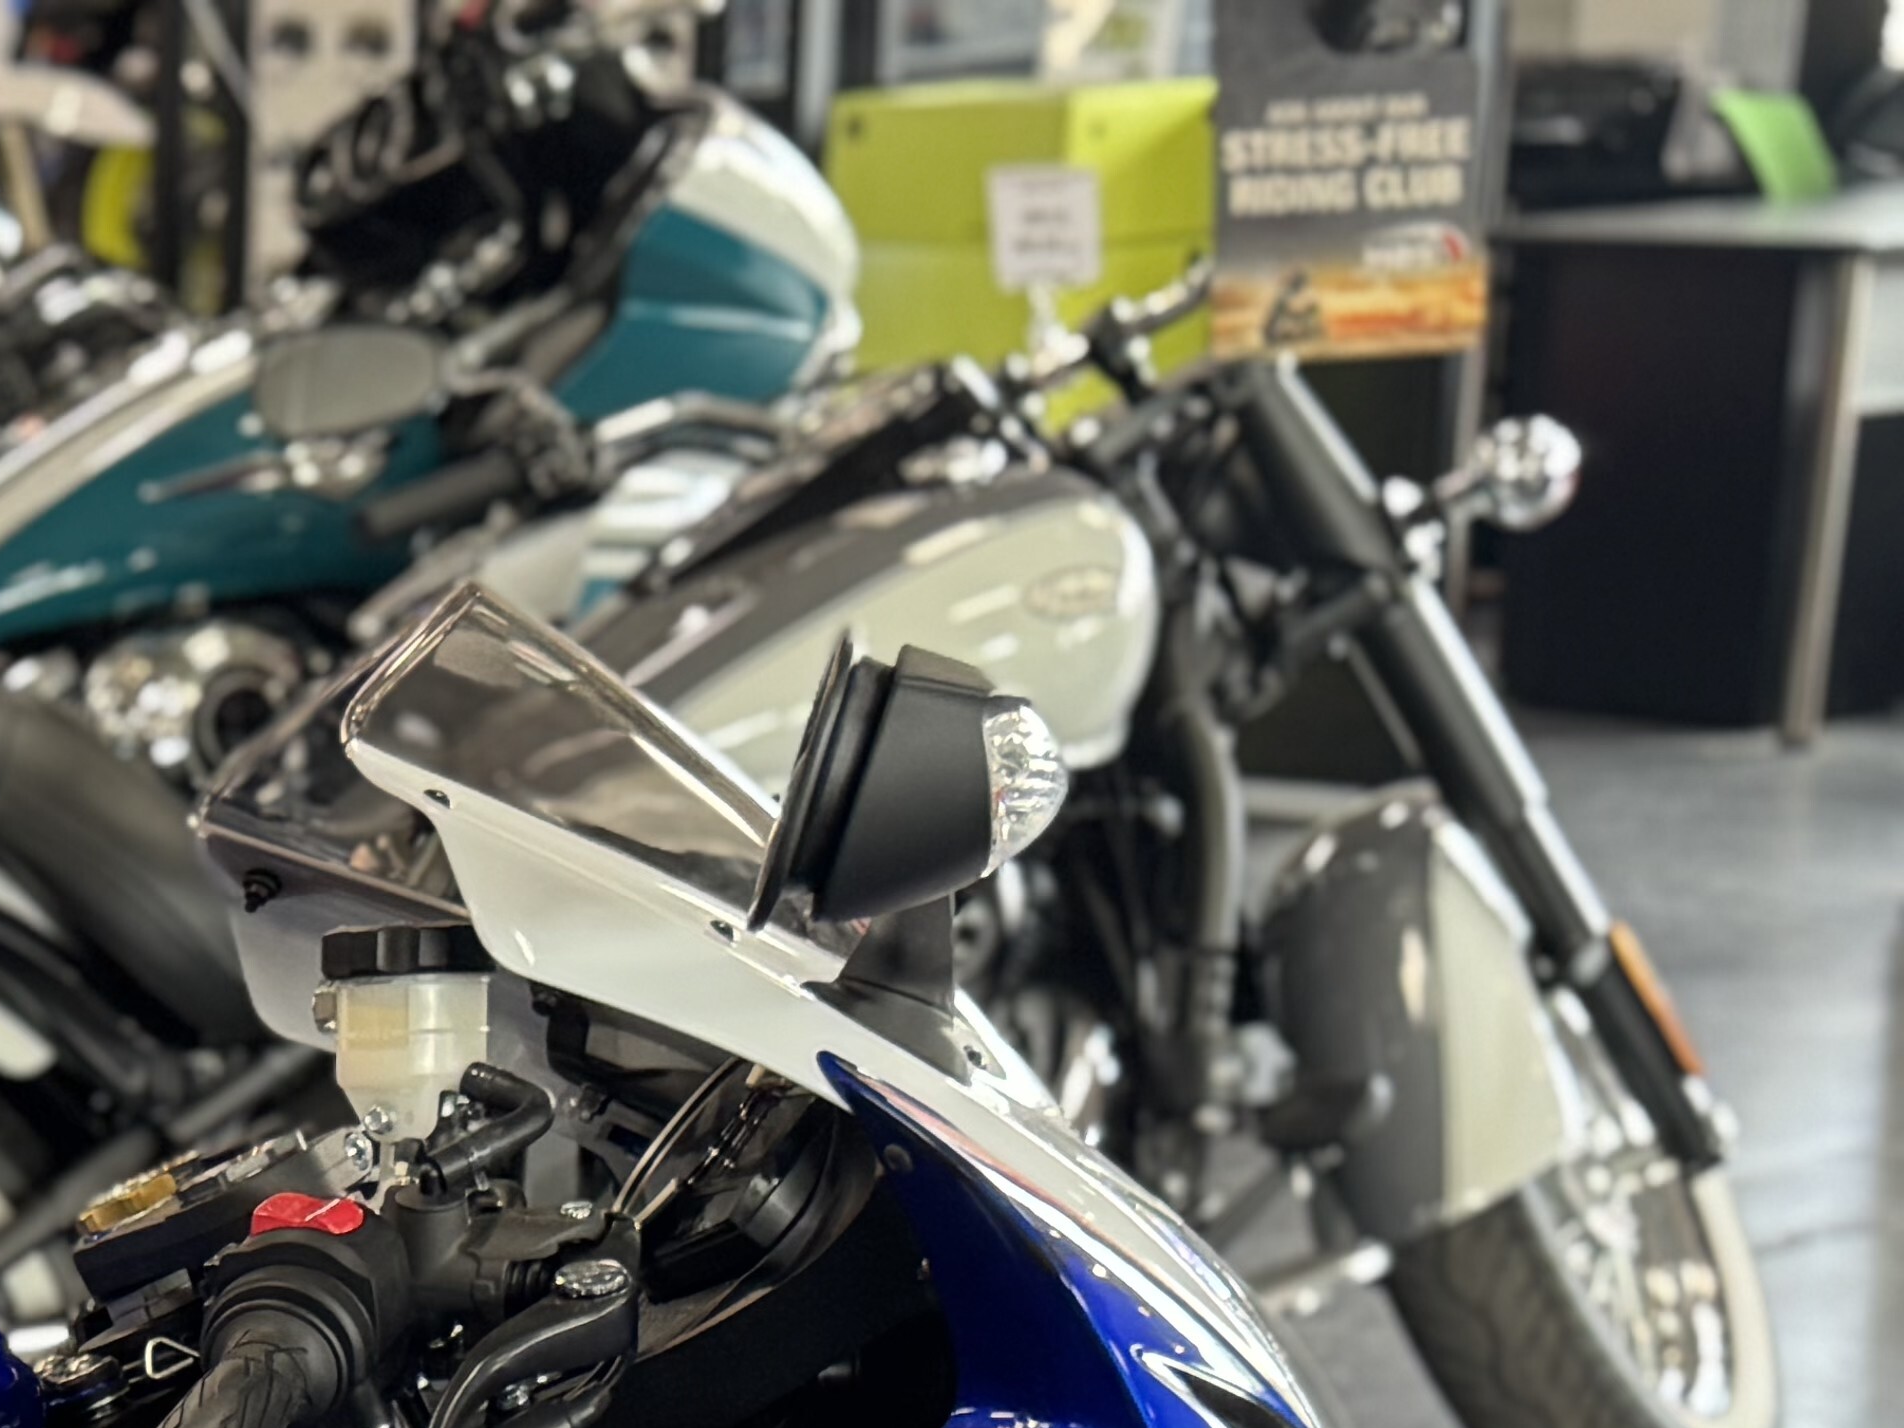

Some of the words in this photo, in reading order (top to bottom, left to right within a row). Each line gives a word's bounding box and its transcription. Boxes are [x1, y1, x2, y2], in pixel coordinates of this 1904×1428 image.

[1222, 116, 1471, 173] STRESS-FREE
[1230, 169, 1356, 217] RIDING
[1363, 163, 1463, 209] CLUB
